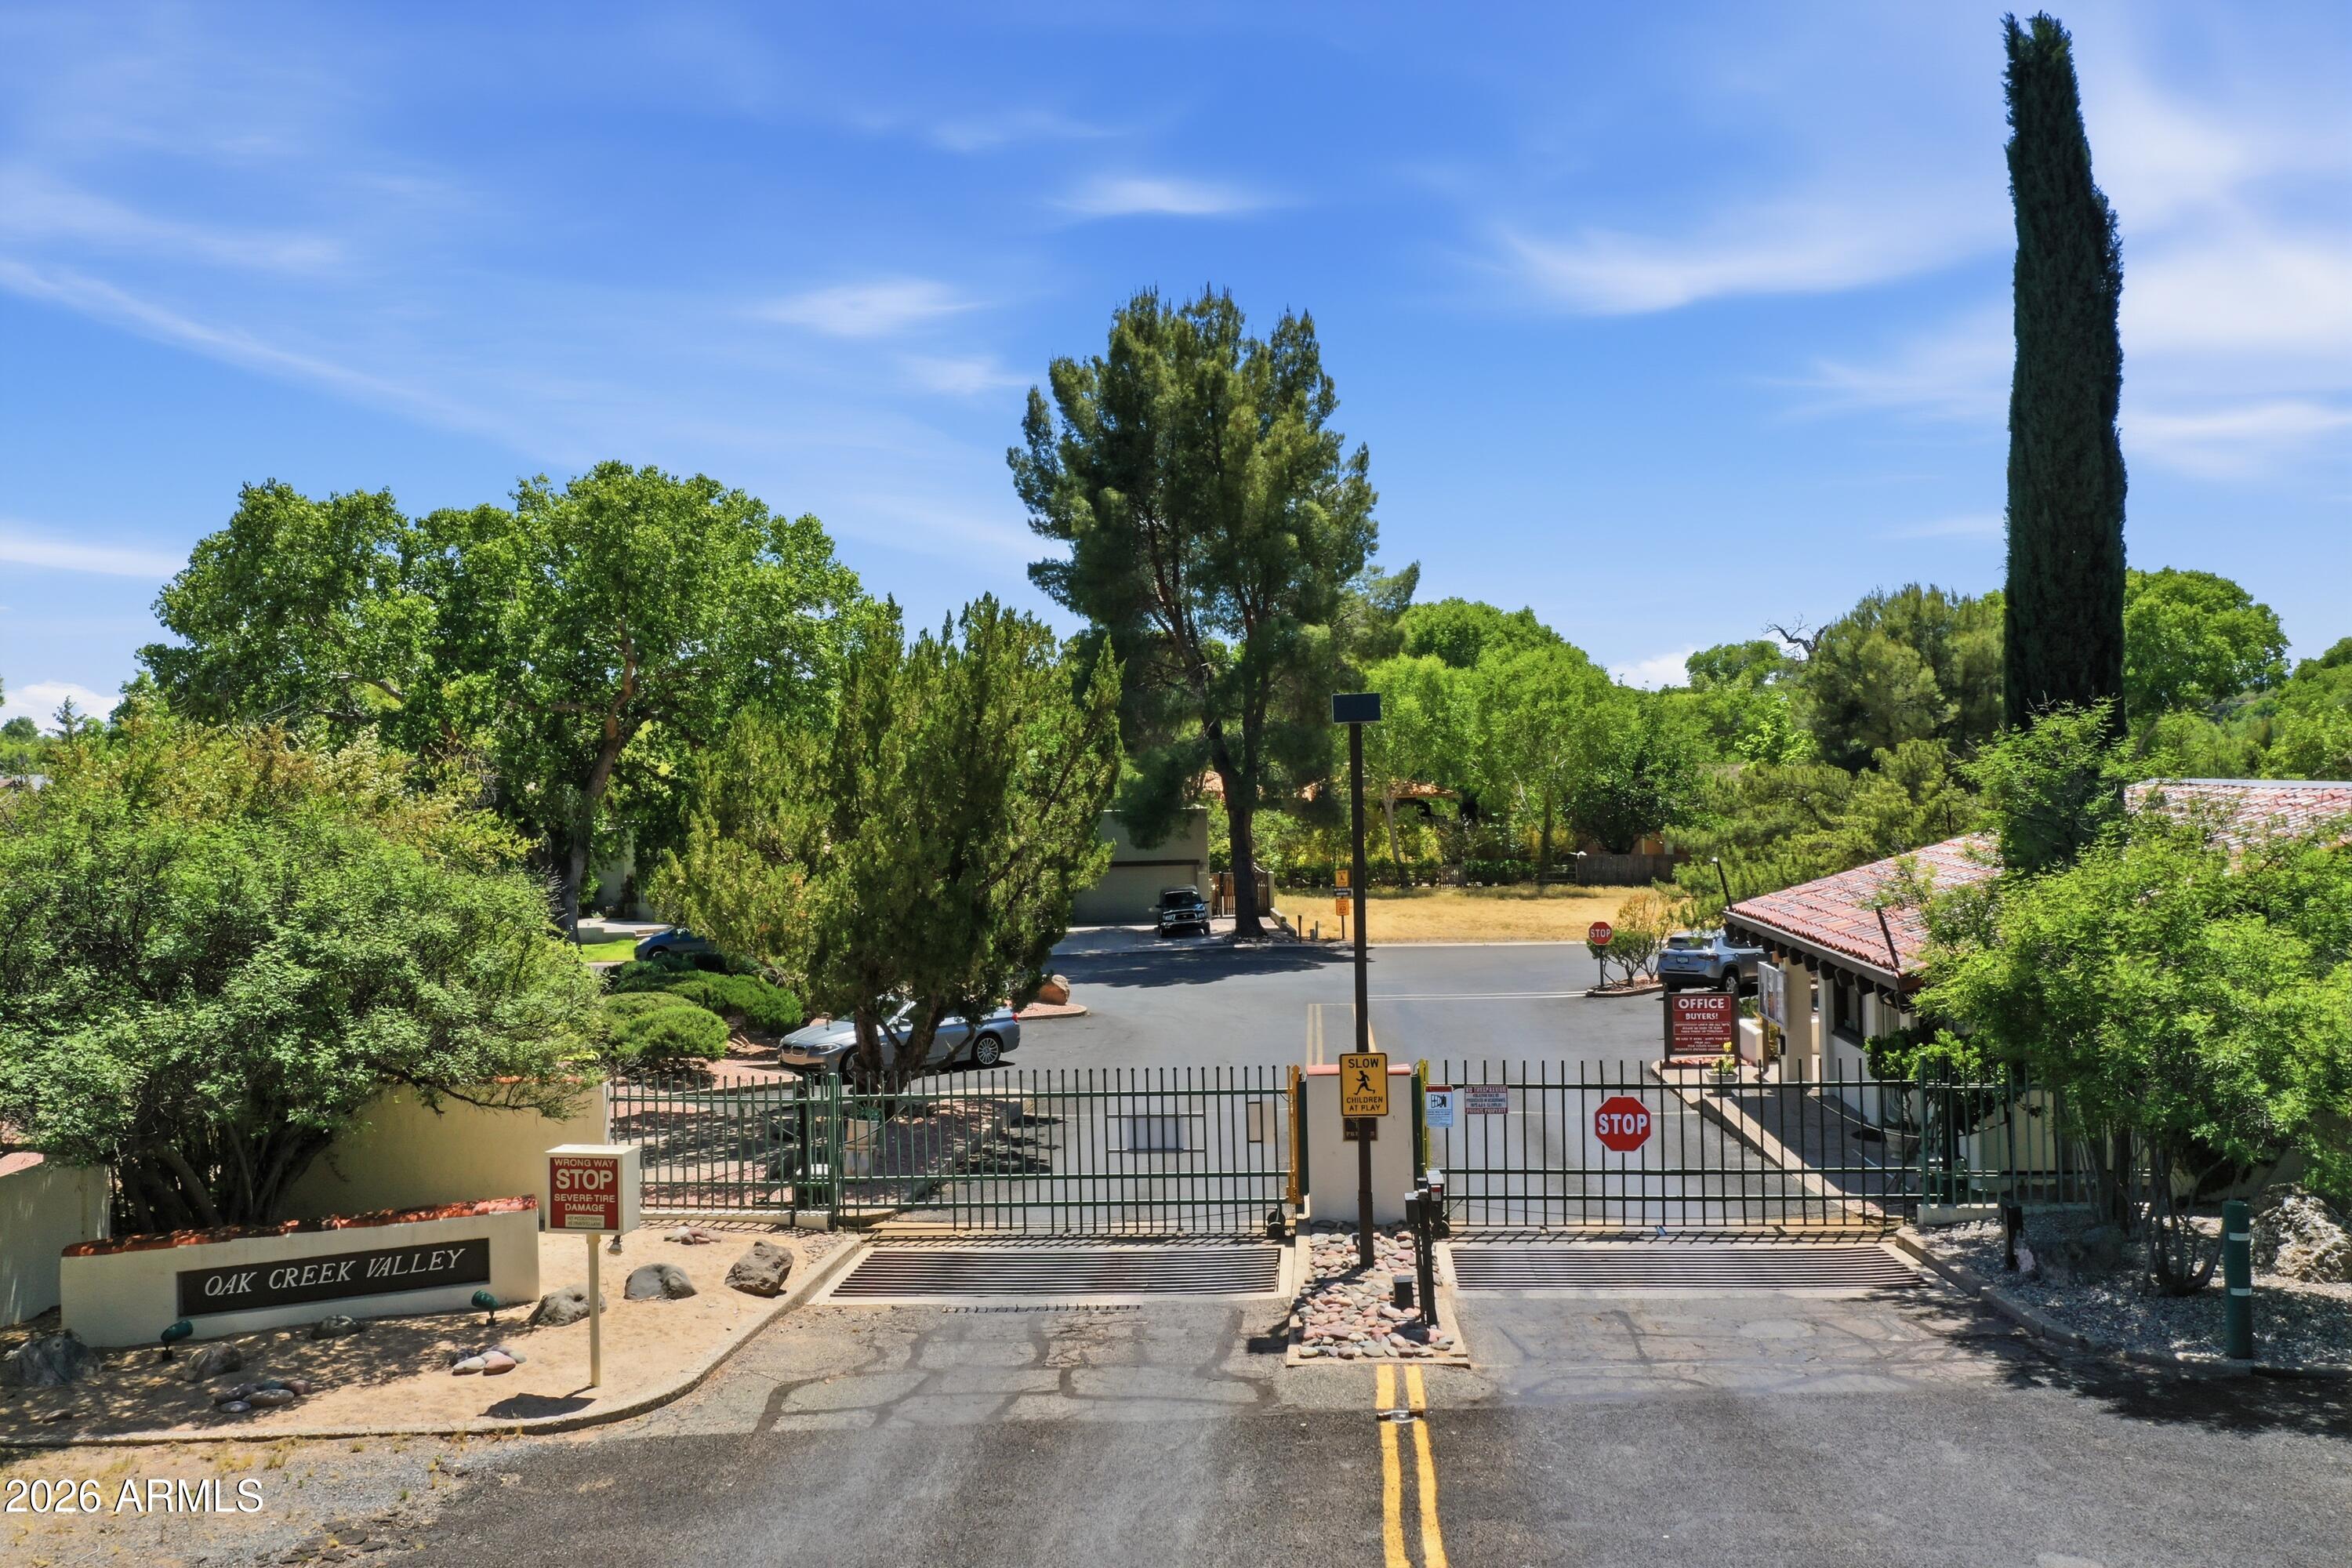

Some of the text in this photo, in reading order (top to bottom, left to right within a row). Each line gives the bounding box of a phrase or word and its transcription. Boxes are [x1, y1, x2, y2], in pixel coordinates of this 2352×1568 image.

[1590, 928, 1611, 938] STOP
[1678, 998, 1725, 1009] OFFICE
[1348, 1058, 1379, 1069] SLOW
[1598, 1113, 1648, 1135] STOP
[554, 1158, 591, 1167] WRONG
[556, 1168, 614, 1190] STOP
[554, 1193, 615, 1203] SEVERE TIRE
[564, 1203, 605, 1212] DAMAGE
[205, 1248, 466, 1296] OAK CREEK VALLEY
